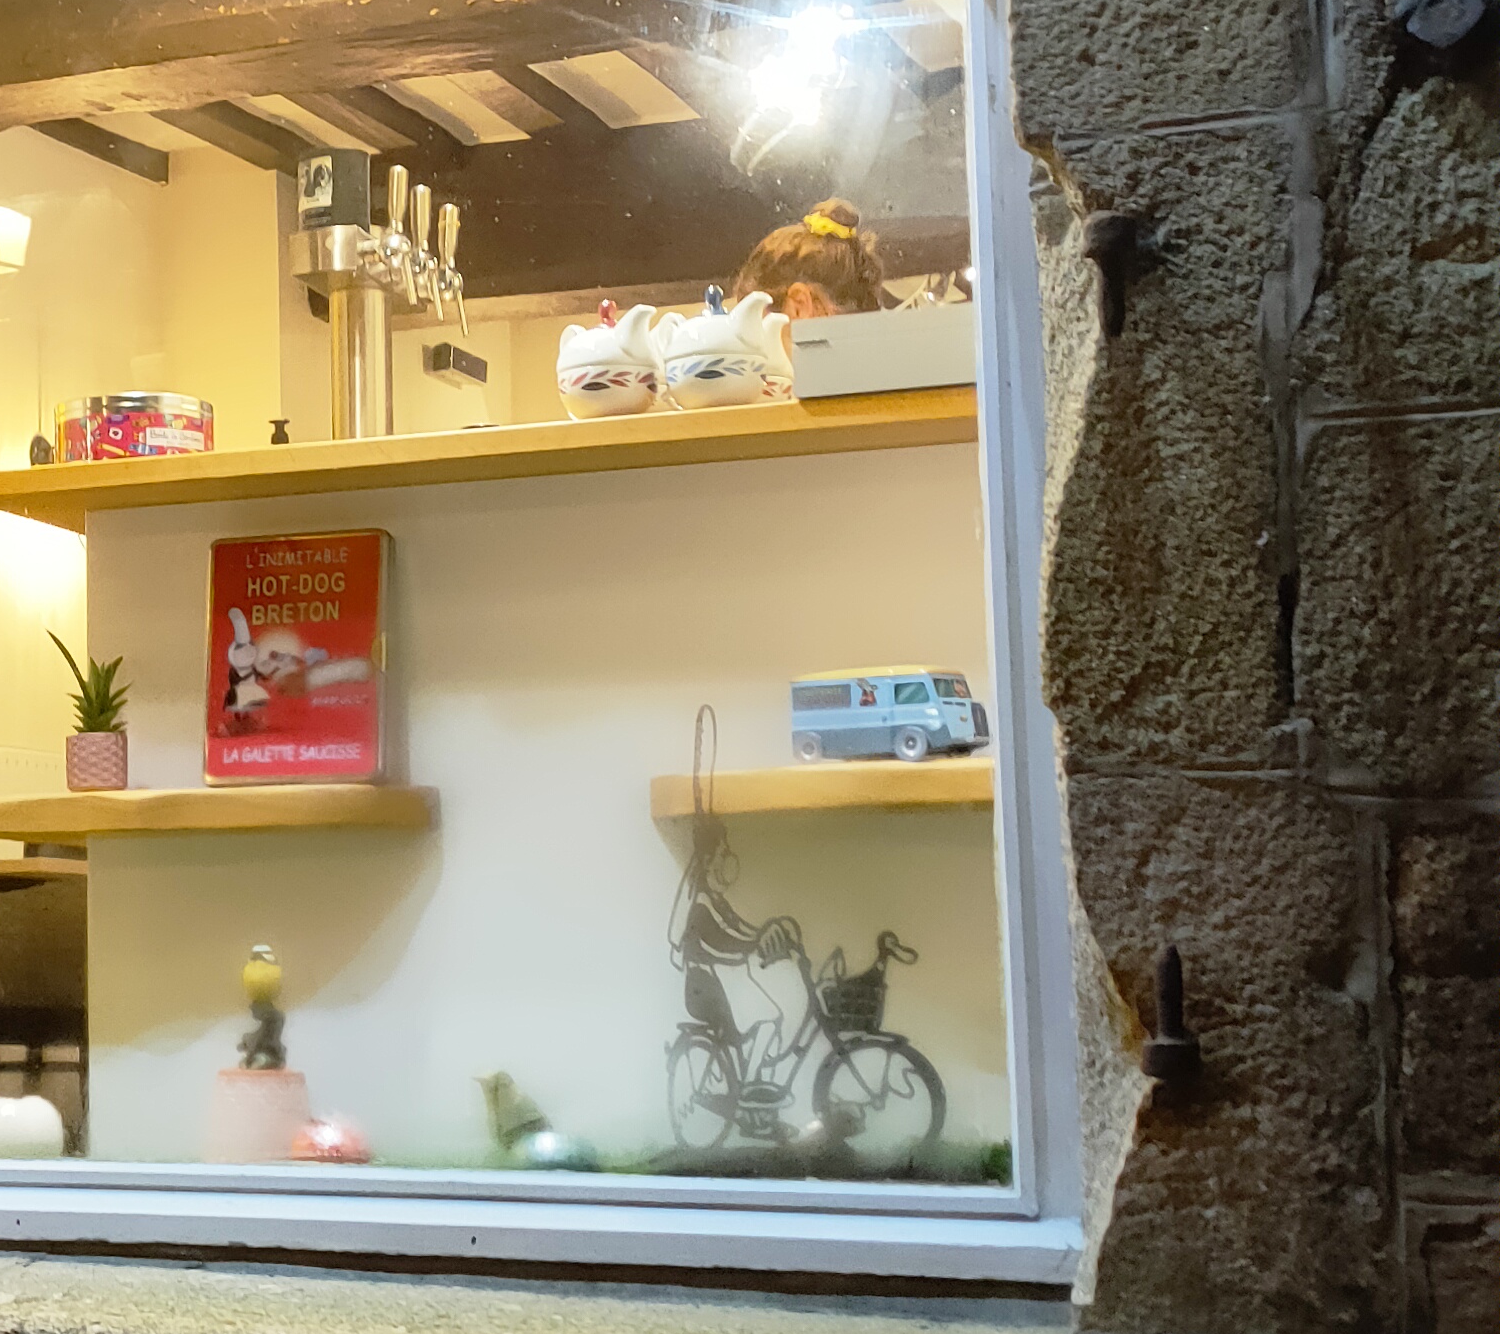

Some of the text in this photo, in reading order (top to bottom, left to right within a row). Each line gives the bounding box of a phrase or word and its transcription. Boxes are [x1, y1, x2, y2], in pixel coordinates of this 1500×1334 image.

[246, 547, 349, 569] L'INIMITABLE
[247, 572, 346, 598] HOT-DOG
[251, 600, 340, 626] BRETON
[223, 746, 239, 764] LA
[242, 744, 296, 763] GALETTE
